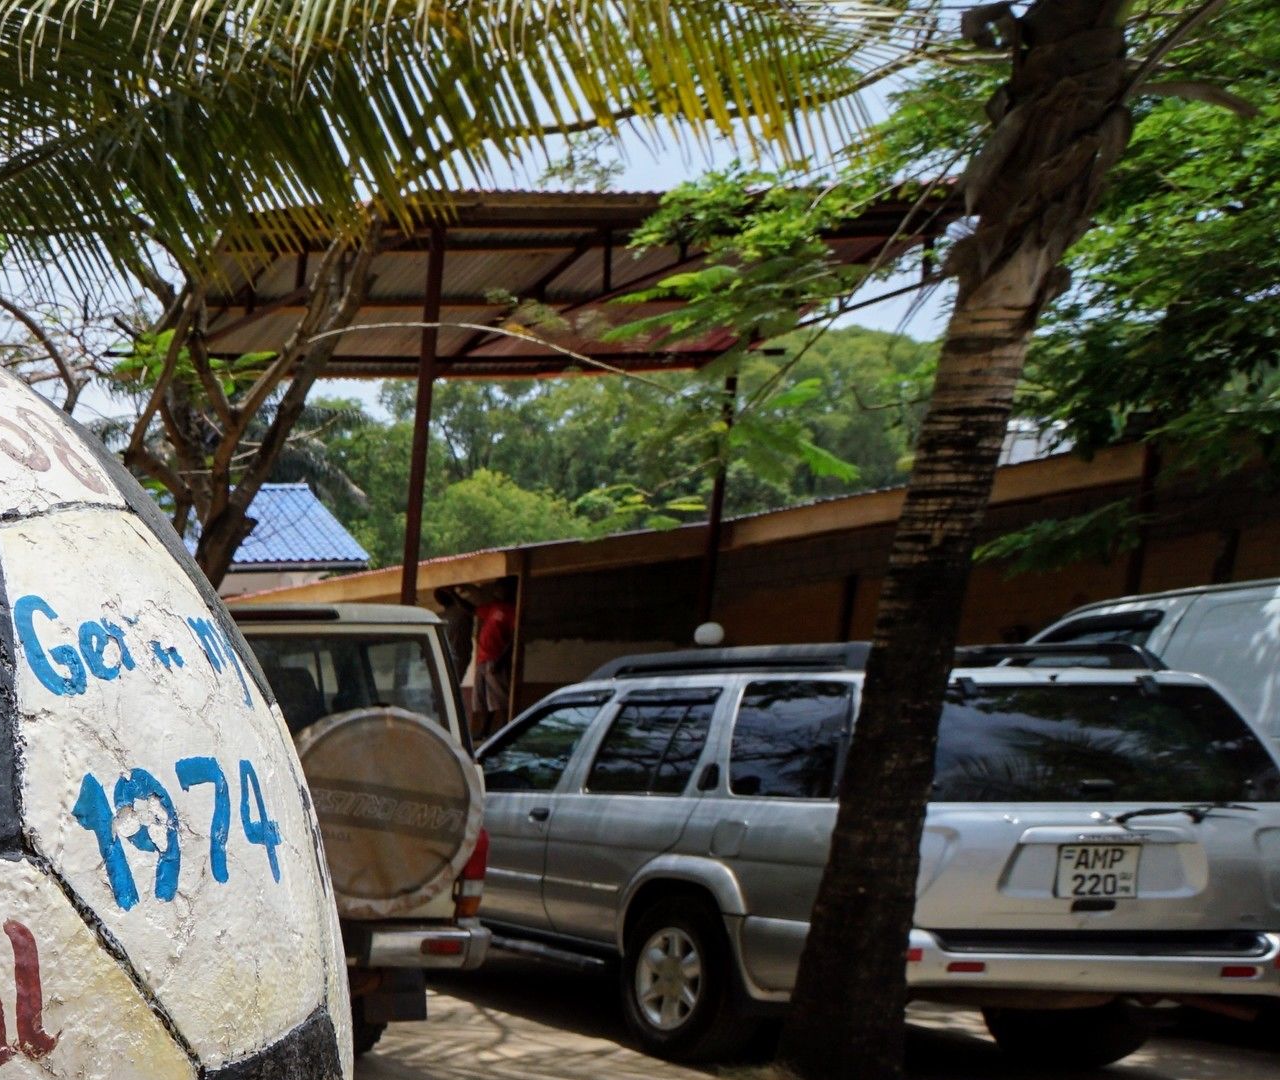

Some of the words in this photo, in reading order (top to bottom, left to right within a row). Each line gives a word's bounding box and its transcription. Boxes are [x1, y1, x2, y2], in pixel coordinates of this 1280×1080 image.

[71, 756, 282, 912] 1974
[1074, 848, 1124, 869] AMP
[1072, 874, 1116, 896] 220
